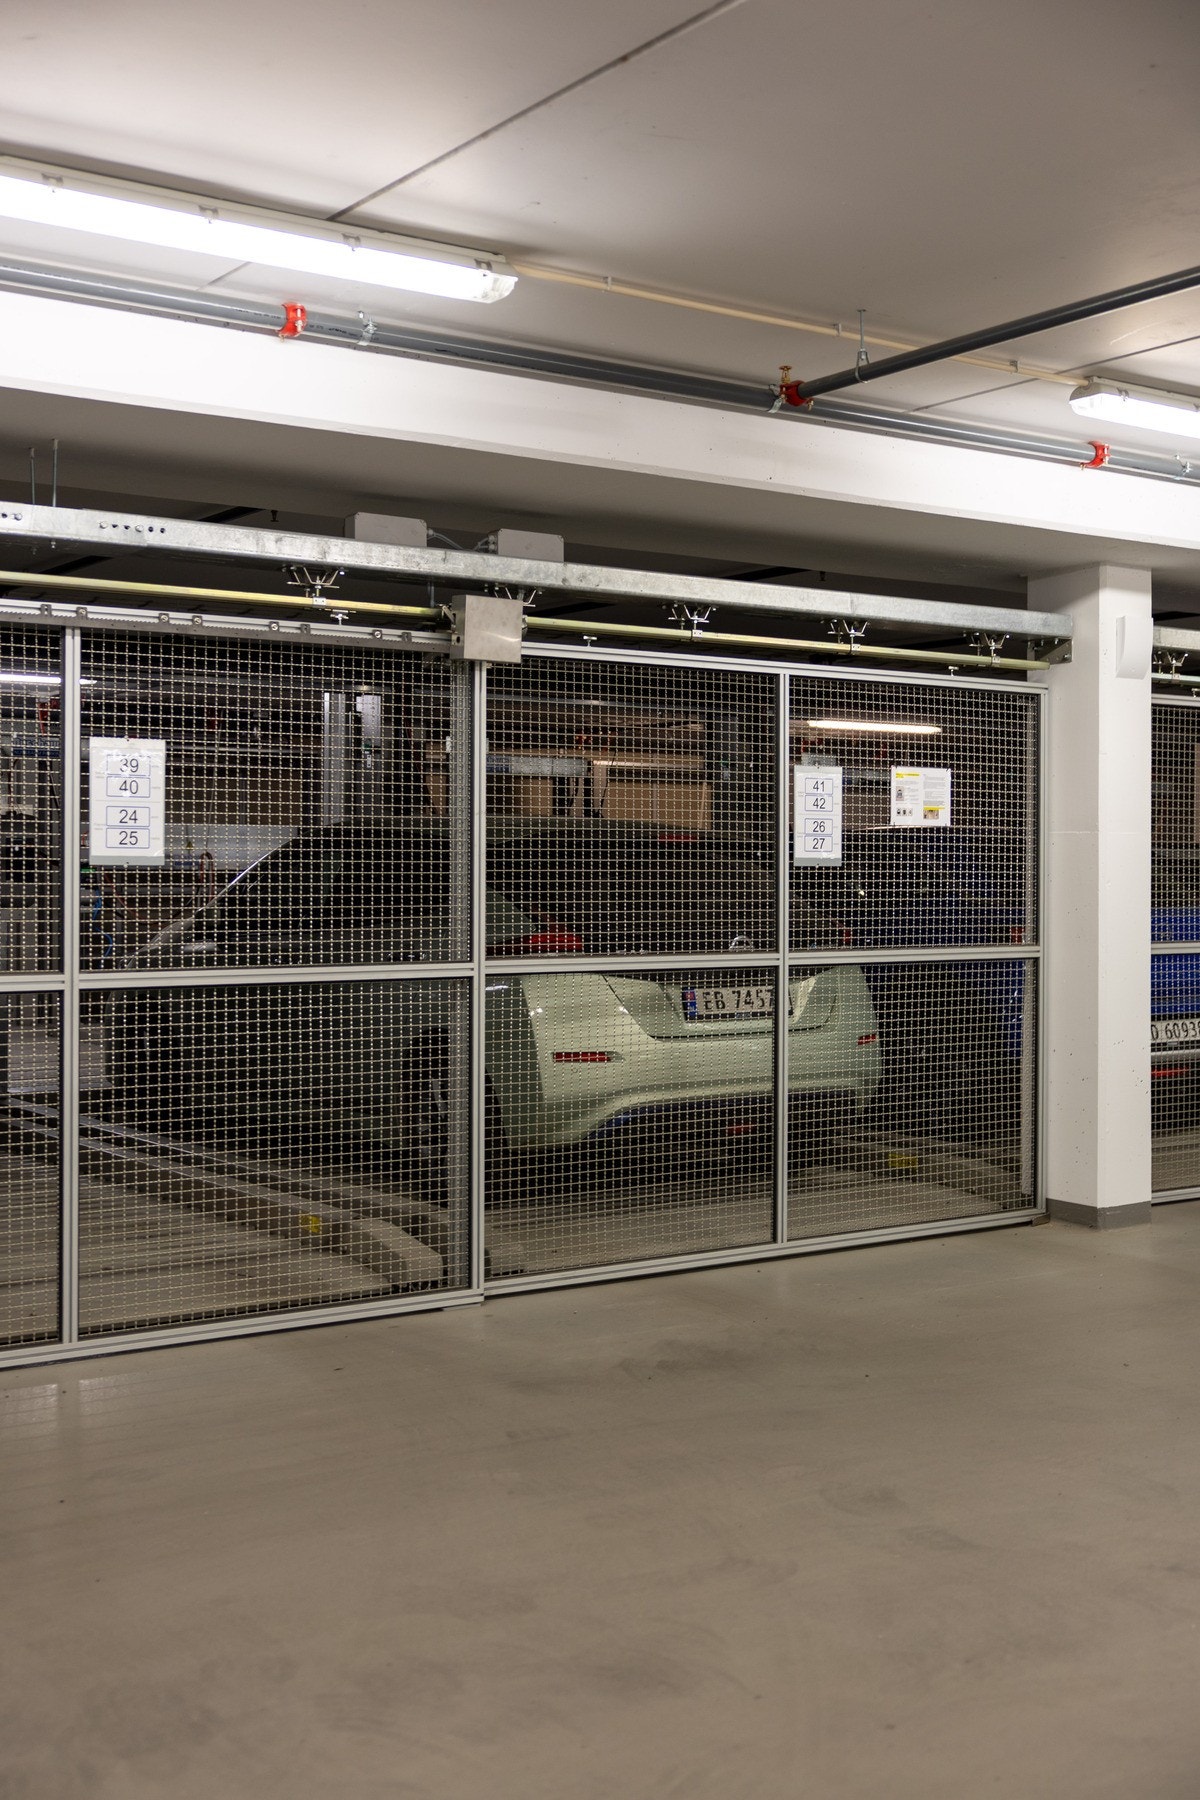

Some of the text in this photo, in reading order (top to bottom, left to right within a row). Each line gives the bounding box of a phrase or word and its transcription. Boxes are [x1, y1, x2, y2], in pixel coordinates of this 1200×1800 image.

[119, 758, 139, 773] 39
[119, 780, 139, 795] 40
[812, 780, 826, 793] 41
[812, 797, 826, 810] 42
[119, 809, 139, 824] 24
[812, 820, 826, 833] 26
[119, 830, 139, 846] 25
[812, 837, 826, 850] 27
